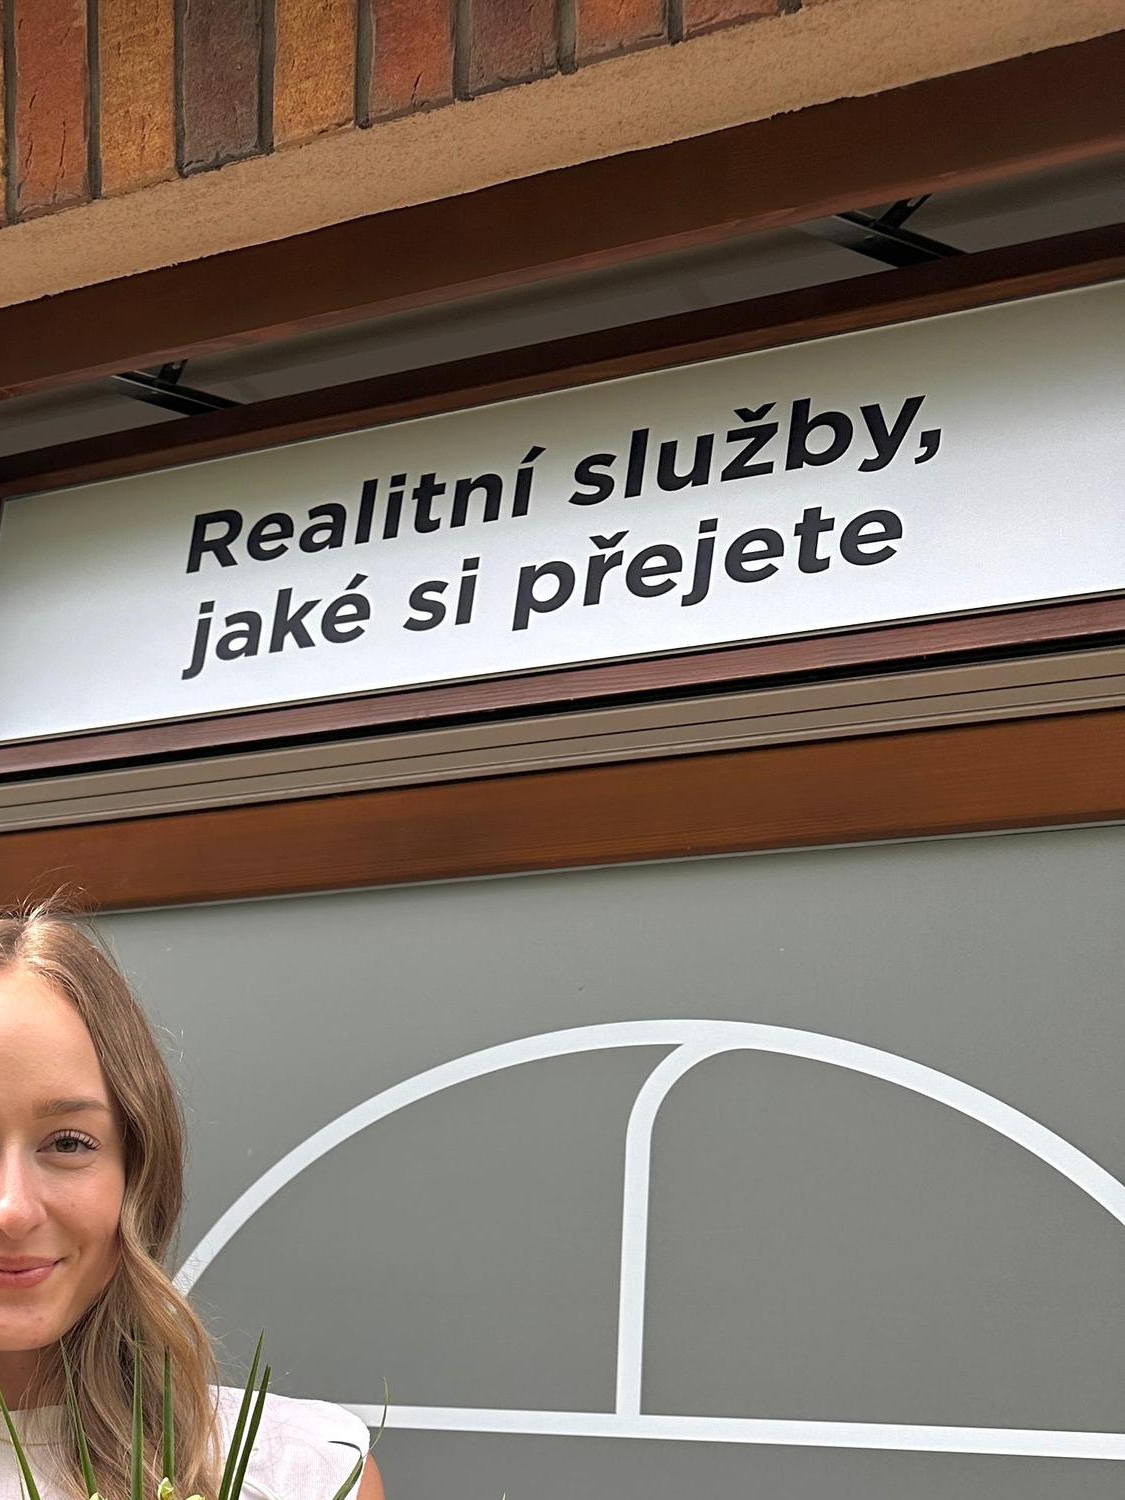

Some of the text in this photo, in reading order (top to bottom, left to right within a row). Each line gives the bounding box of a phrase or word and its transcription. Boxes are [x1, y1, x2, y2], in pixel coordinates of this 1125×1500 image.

[185, 394, 942, 574] Realitní služby,
[181, 506, 903, 680] jaké si přejete
